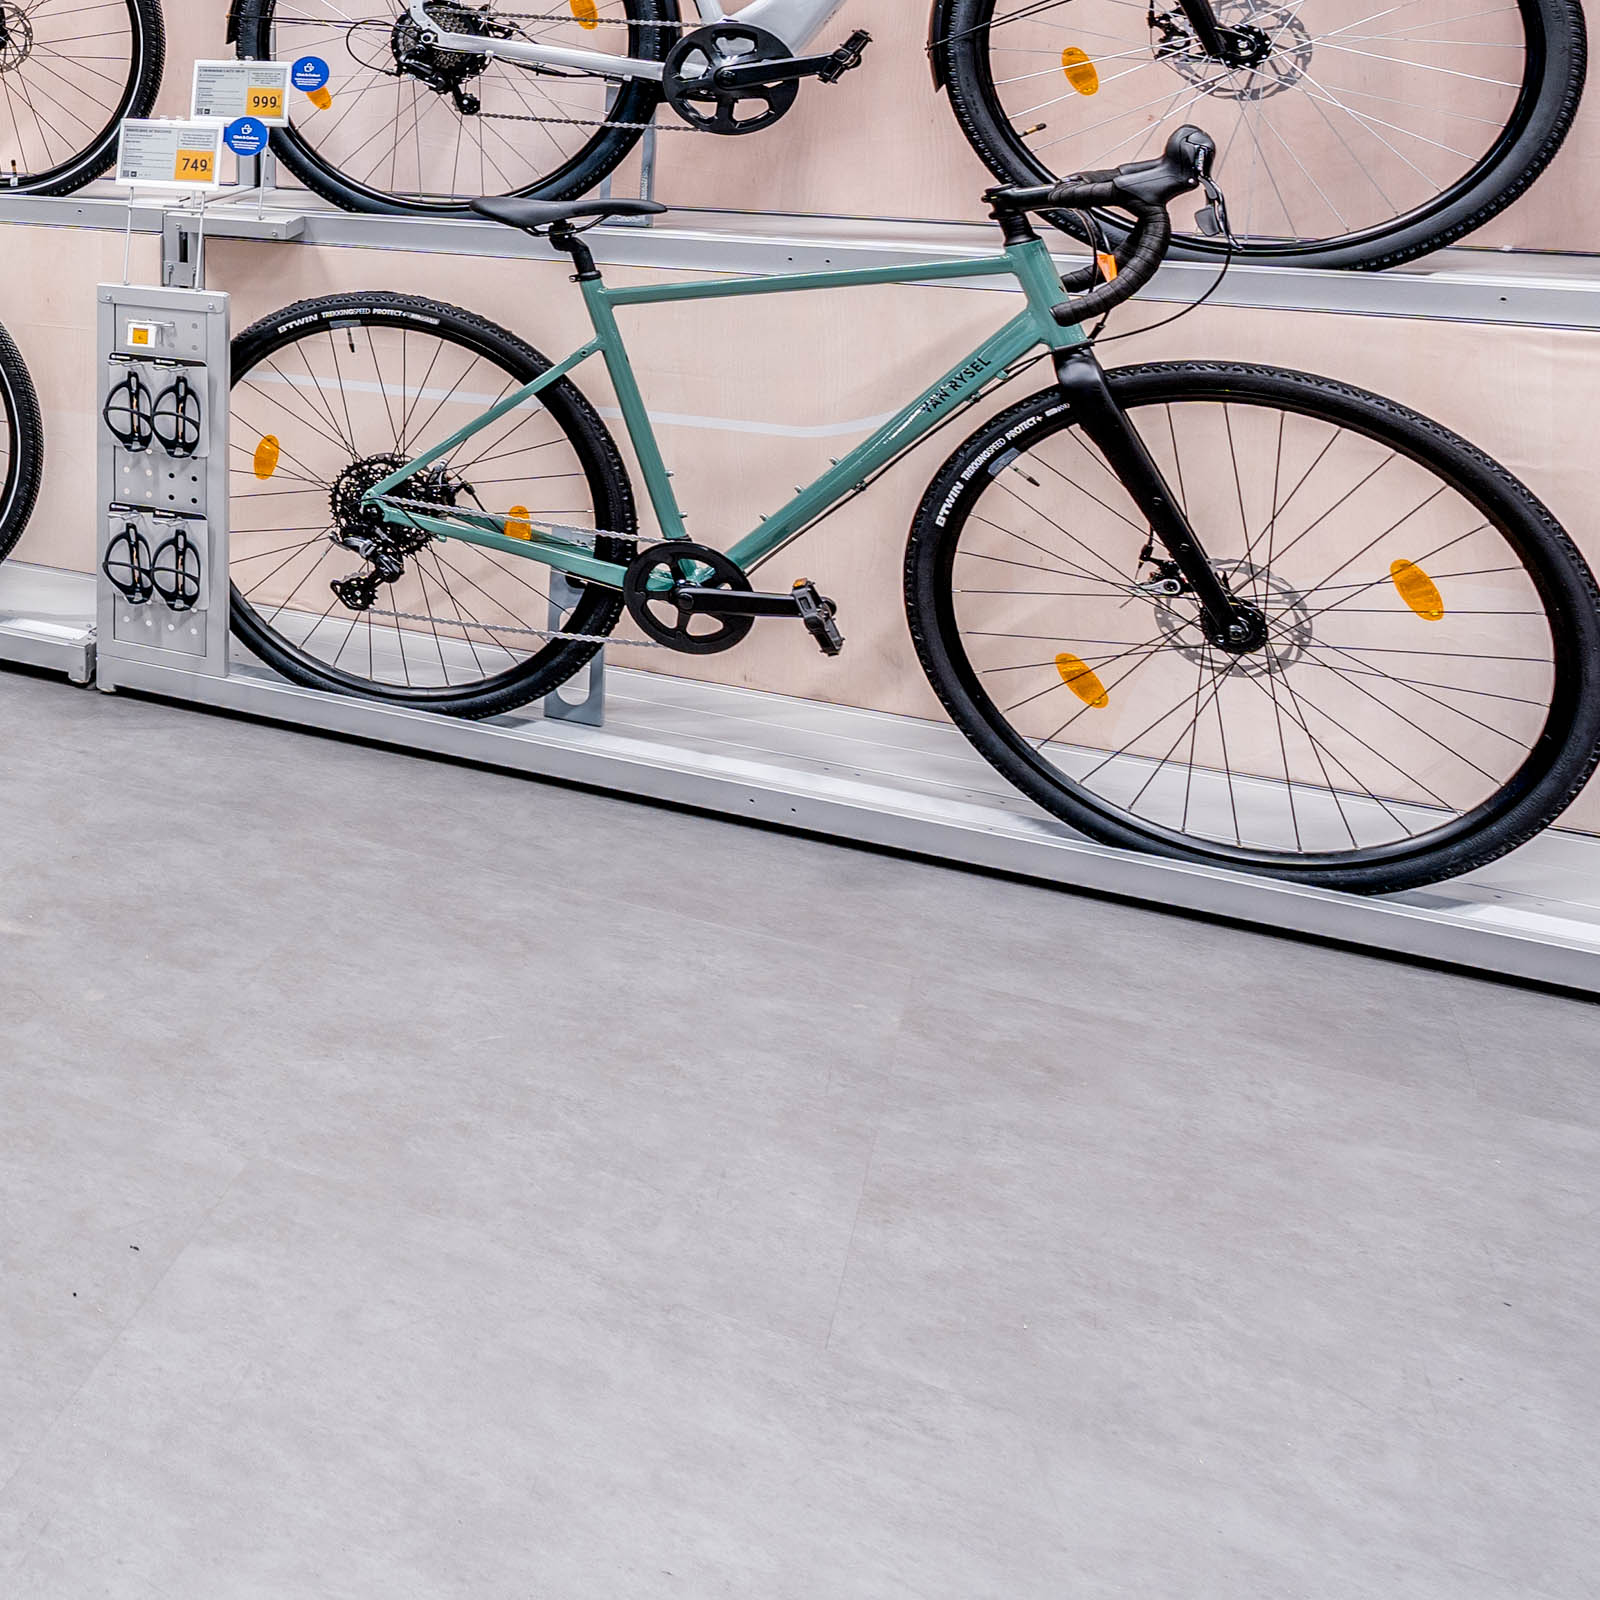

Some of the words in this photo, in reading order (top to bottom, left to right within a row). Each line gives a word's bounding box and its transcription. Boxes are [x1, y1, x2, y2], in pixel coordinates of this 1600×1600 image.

[252, 95, 278, 109] 999
[181, 157, 208, 172] 749
[920, 389, 951, 414] VAN
[949, 357, 992, 392] RYSEL
[961, 437, 1007, 481] TREKKINGSPEED
[1005, 415, 1044, 441] PROTECT+
